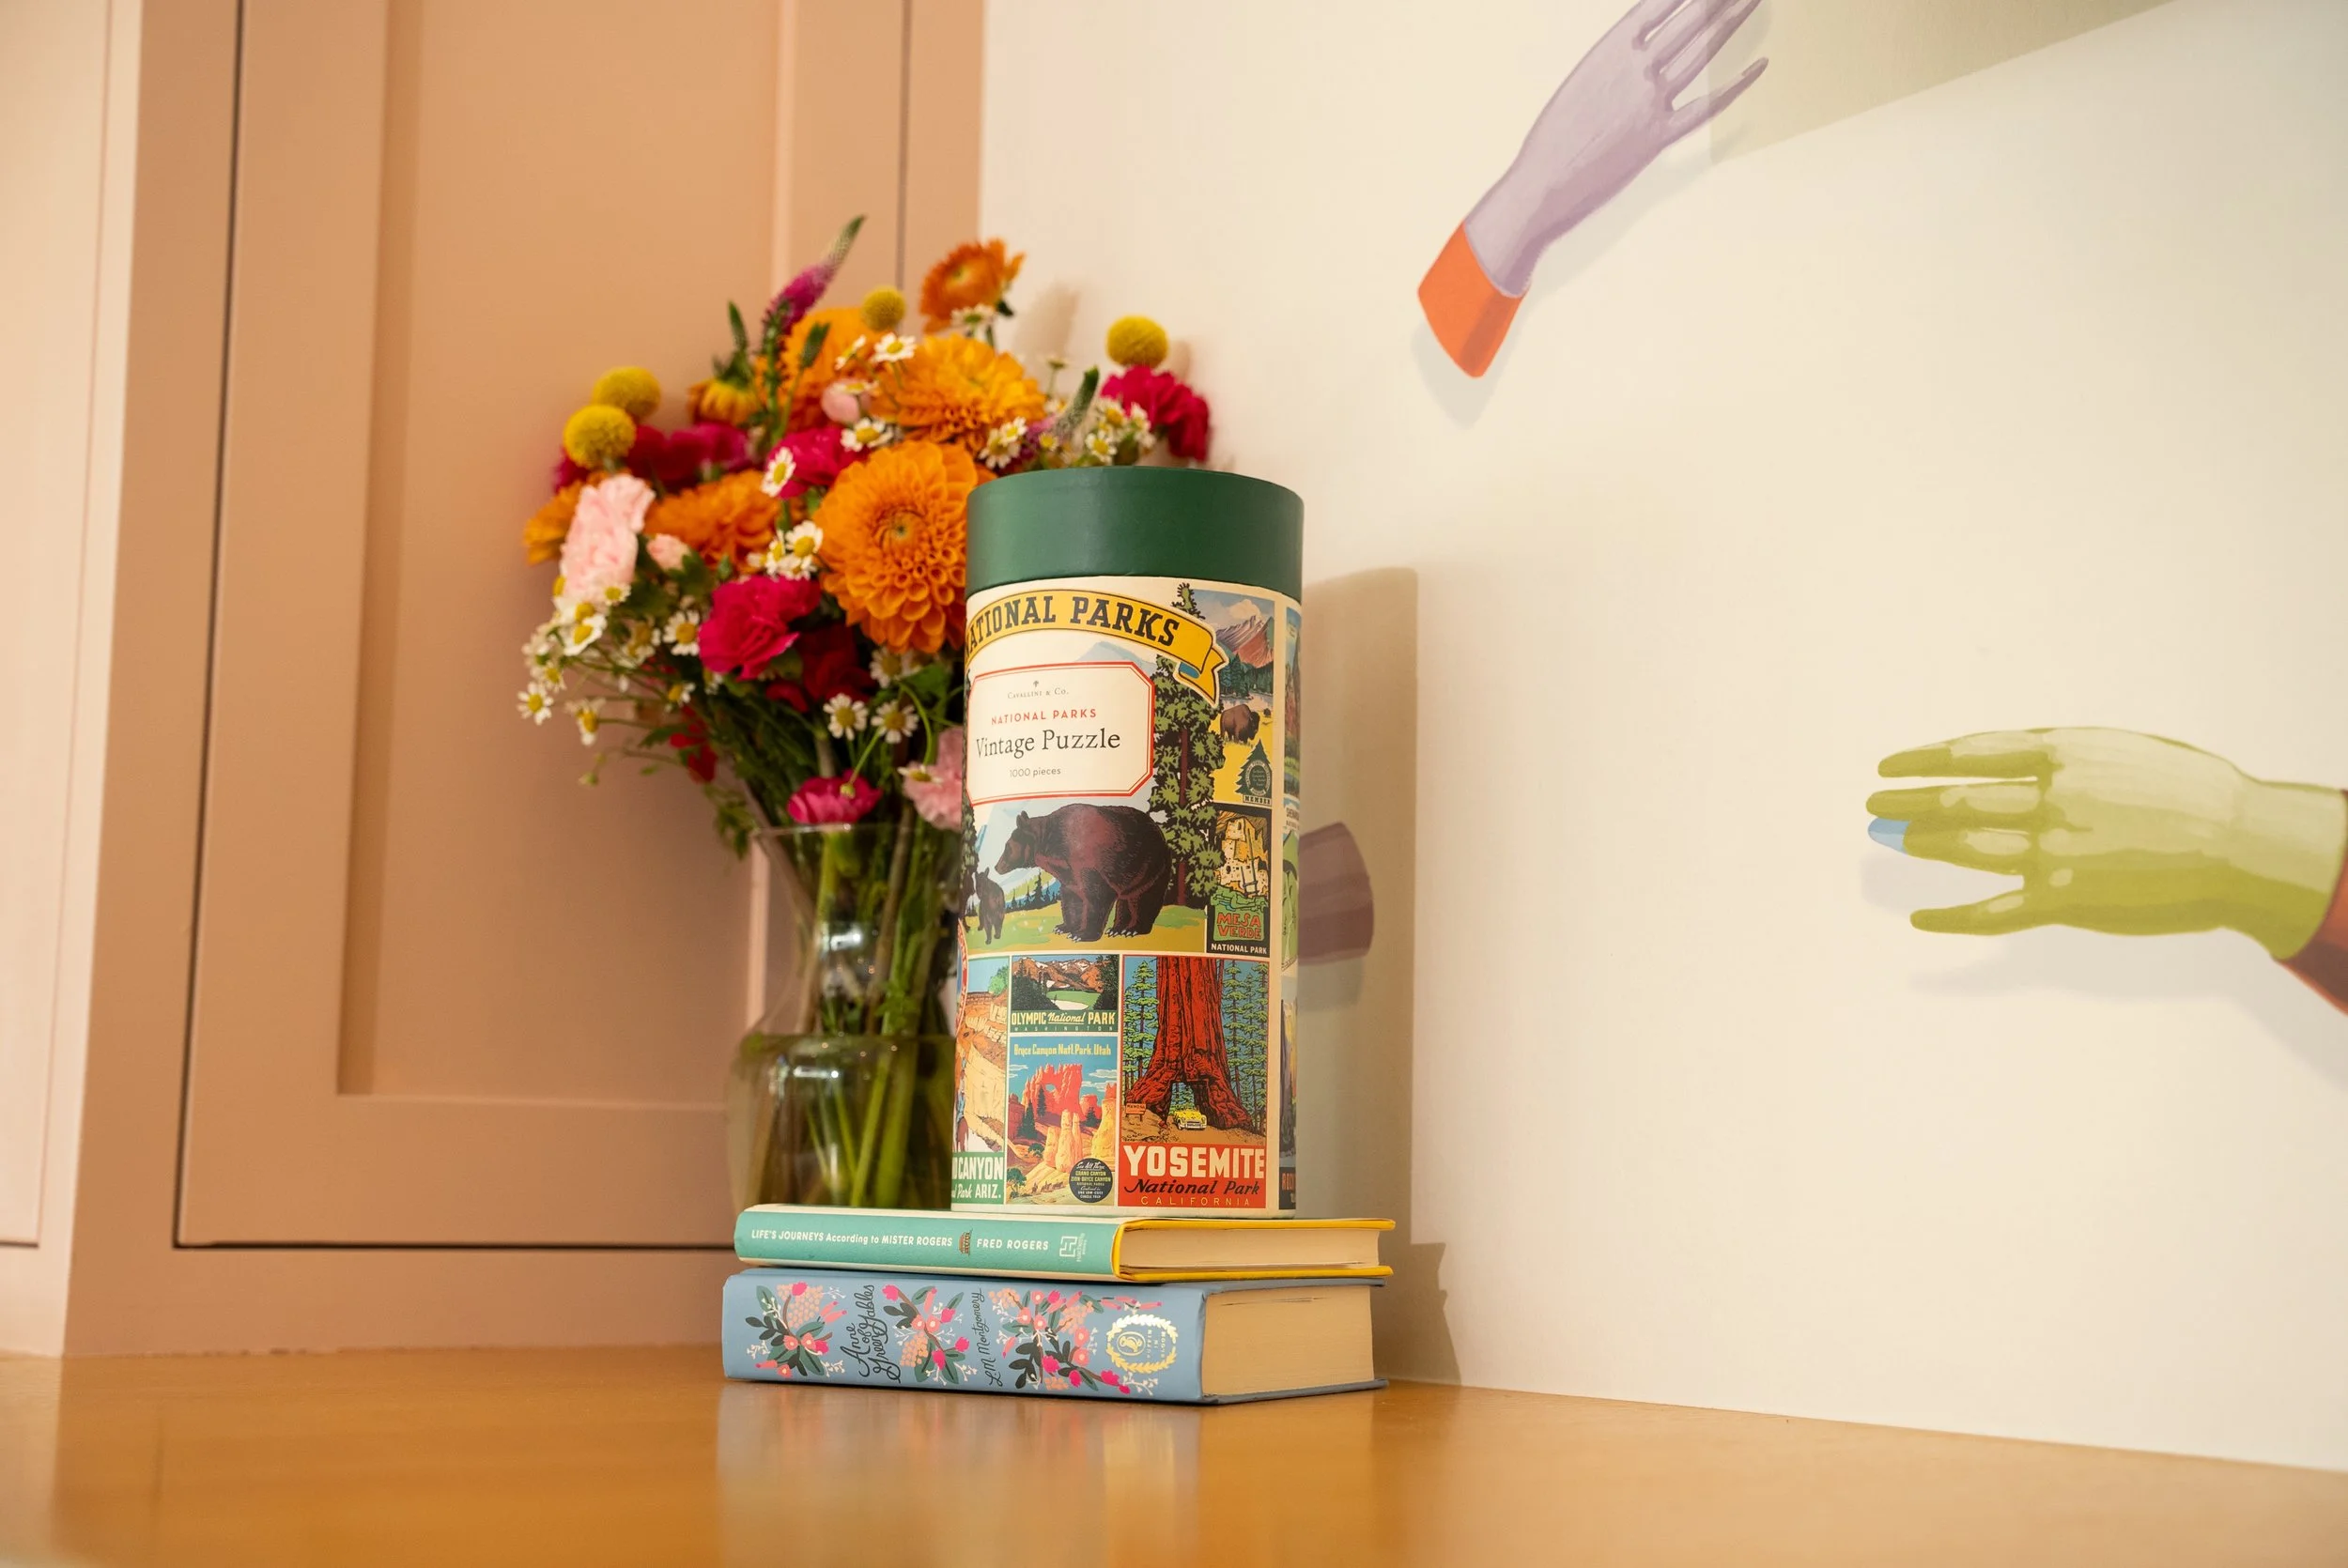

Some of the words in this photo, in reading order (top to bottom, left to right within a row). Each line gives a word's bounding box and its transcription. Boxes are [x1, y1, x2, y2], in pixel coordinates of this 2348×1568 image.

[1069, 596, 1181, 647] PARKS
[991, 711, 1046, 725] NATIONAL
[1053, 708, 1097, 719] PARKS
[976, 736, 1035, 759] Vintage
[1042, 727, 1120, 750] Puzzle
[1010, 767, 1031, 777] 1000
[1032, 766, 1061, 777] pieces
[1216, 912, 1261, 928] MESA
[1217, 925, 1262, 939] VERDE
[1211, 943, 1249, 953] NATIONAL
[1250, 945, 1267, 954] PARK
[1012, 1012, 1047, 1025] OLYMPIC
[1047, 1012, 1086, 1023] National
[1088, 1012, 1116, 1024] PARK
[1013, 1044, 1031, 1057] Bryce
[1032, 1043, 1058, 1056] Canyon
[1093, 1044, 1111, 1055] Utah
[958, 1157, 1003, 1180] CANYON
[1123, 1145, 1265, 1179] YOSEMITE
[957, 1183, 972, 1199] Park
[974, 1184, 1001, 1199] ARIZ.
[1124, 1178, 1218, 1194] National
[1224, 1180, 1259, 1195] Park
[1141, 1196, 1250, 1207] CALIFORNIA
[751, 1229, 778, 1240] LIFE'S
[779, 1230, 825, 1241] JOURNEYS
[826, 1232, 869, 1245] According
[871, 1235, 879, 1244] to
[881, 1235, 914, 1245] MISTER
[916, 1236, 953, 1247] ROGERS
[977, 1237, 1003, 1249] FRED
[1006, 1239, 1049, 1251] ROGERS
[854, 1284, 888, 1345] Gables
[970, 1288, 991, 1356] Montgomery
[857, 1327, 873, 1345] of
[840, 1322, 871, 1377] Anne
[868, 1330, 902, 1384] Green
